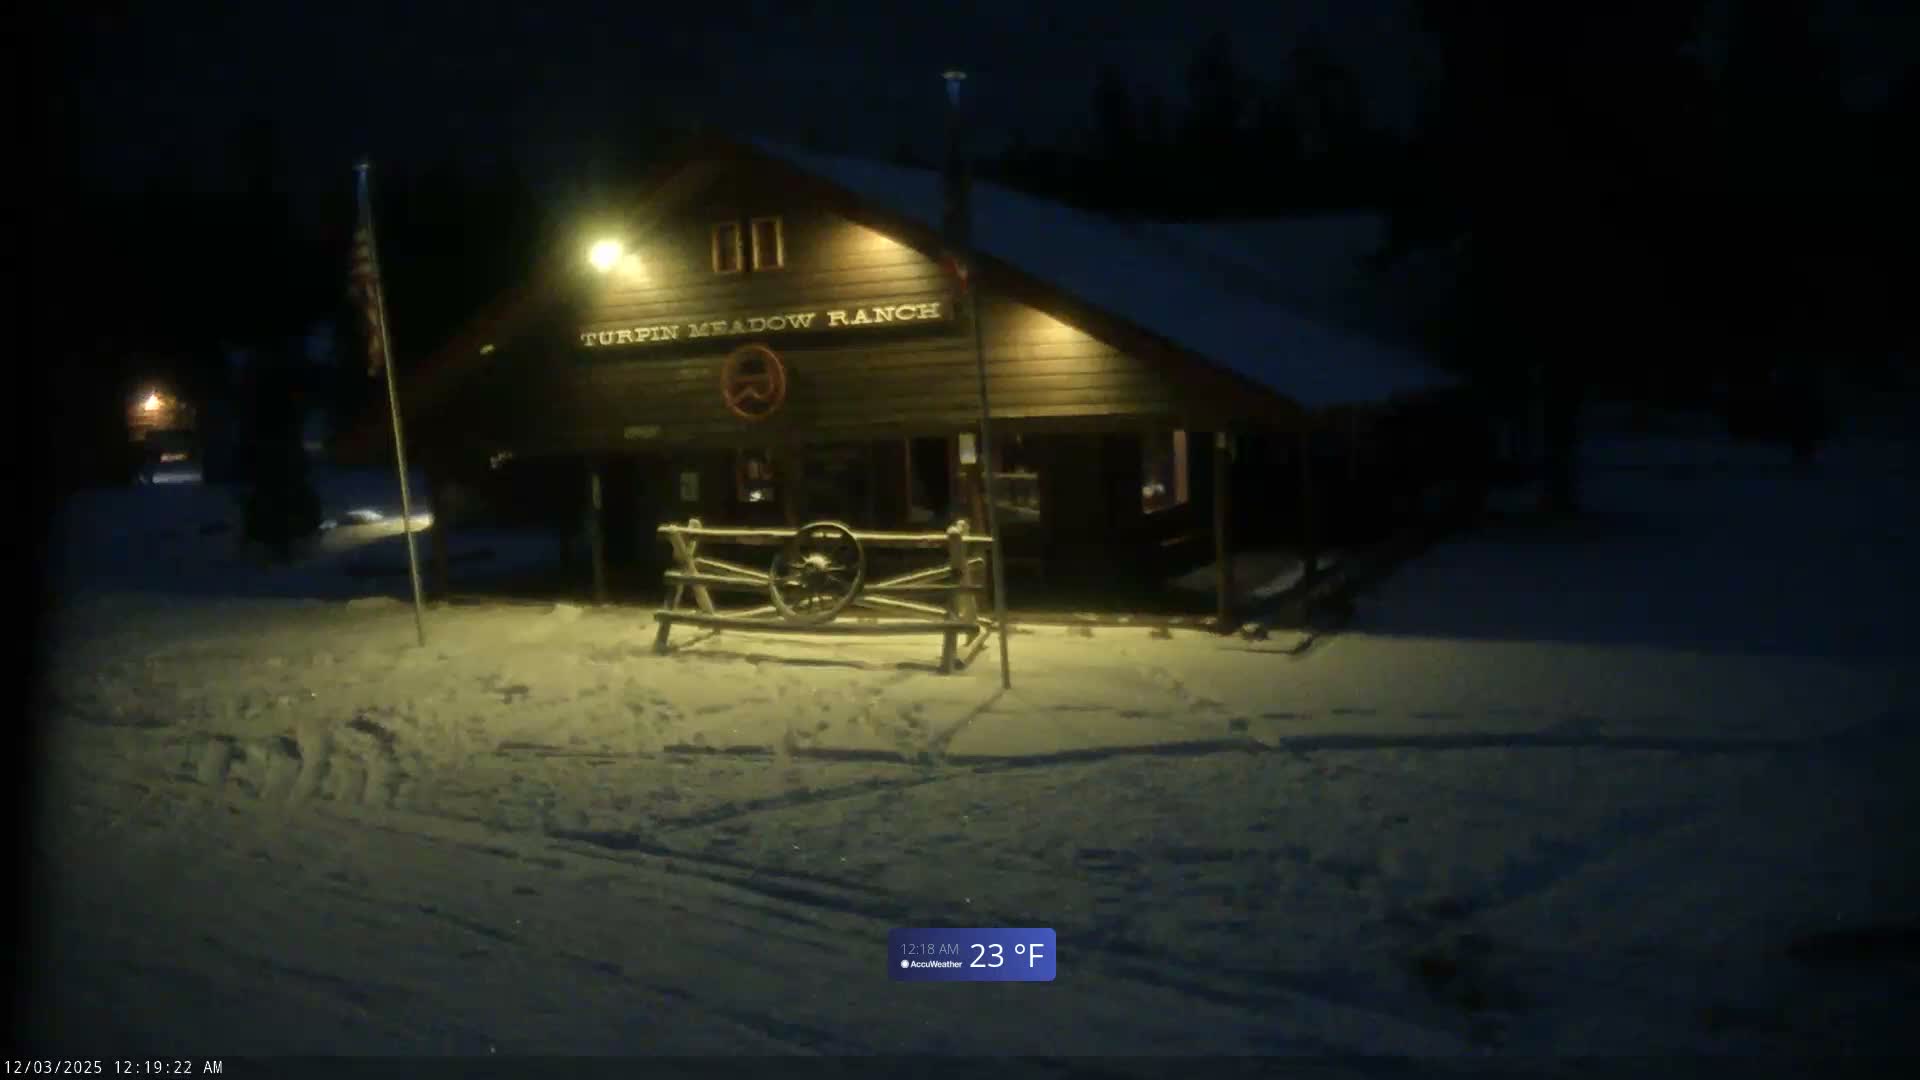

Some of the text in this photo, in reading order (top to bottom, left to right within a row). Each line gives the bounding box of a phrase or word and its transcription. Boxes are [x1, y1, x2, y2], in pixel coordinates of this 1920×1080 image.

[580, 302, 942, 347] TURPIN MEADOW RANCH
